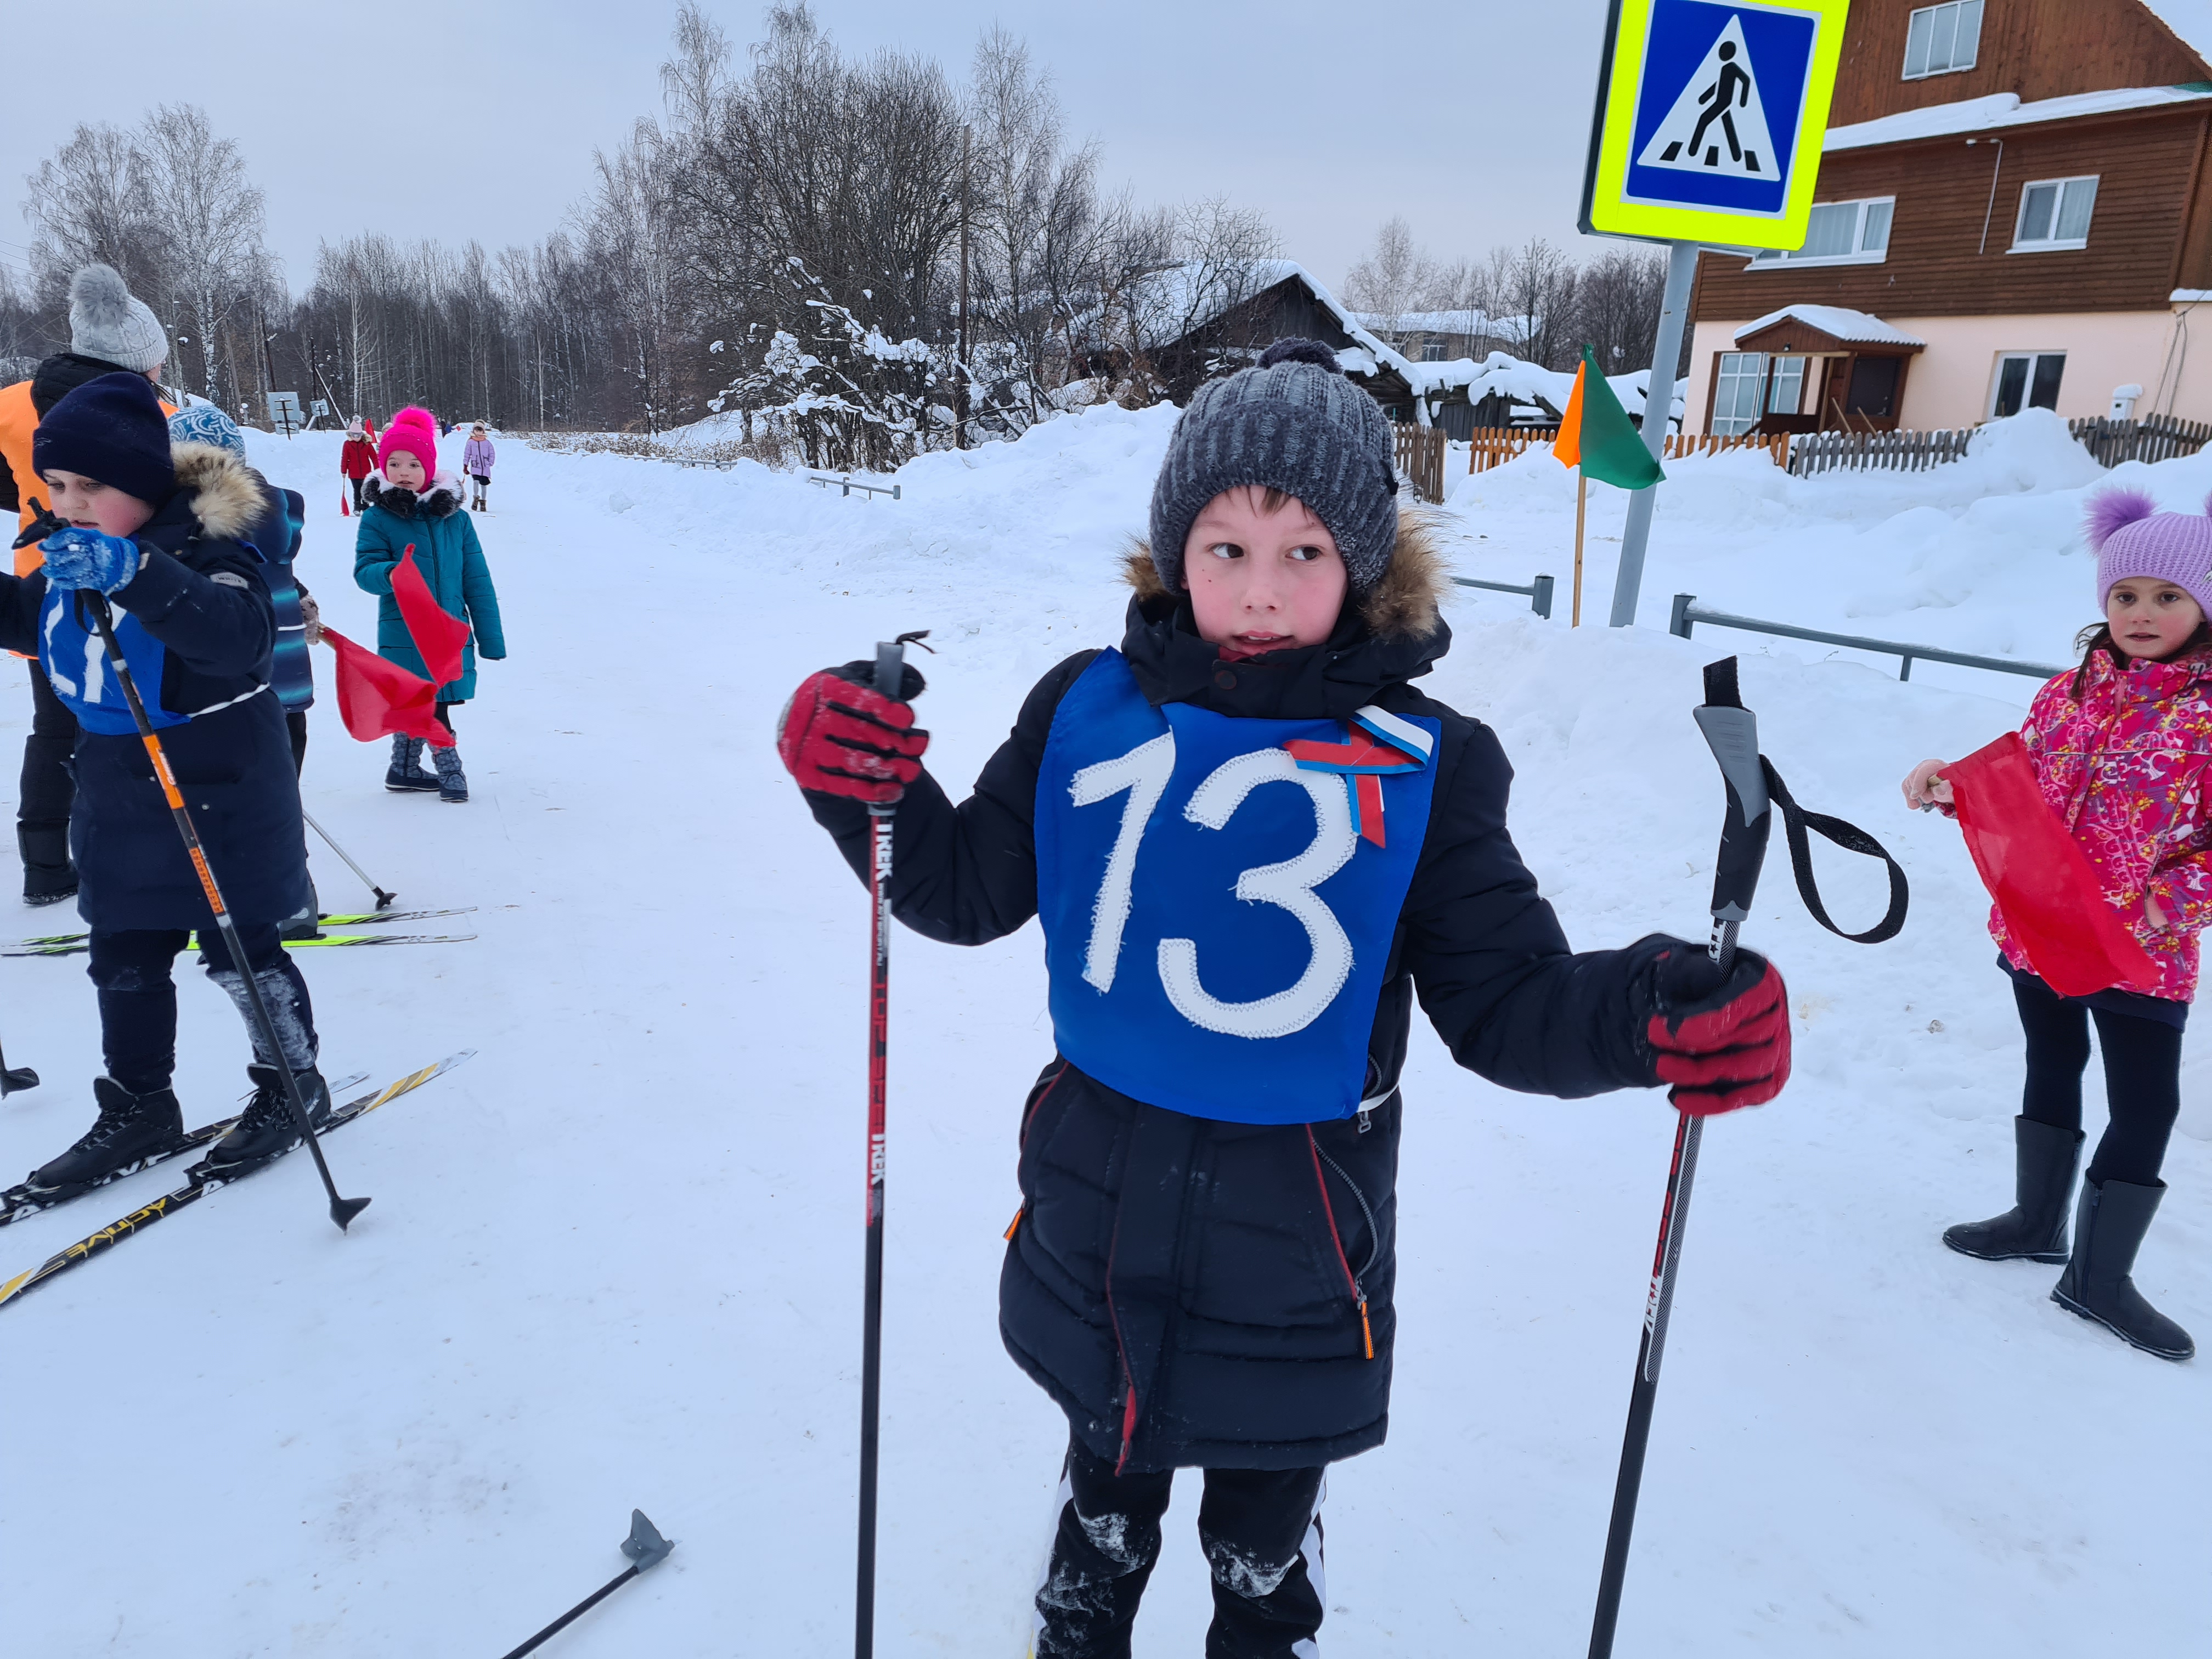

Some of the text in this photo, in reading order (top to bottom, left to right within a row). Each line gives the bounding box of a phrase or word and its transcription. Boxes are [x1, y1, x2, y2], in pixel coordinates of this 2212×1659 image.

[875, 821, 894, 882] TREK
[1067, 725, 1357, 1039] 13
[871, 1132, 886, 1186] TREK
[65, 1198, 167, 1258] ACTIVE
